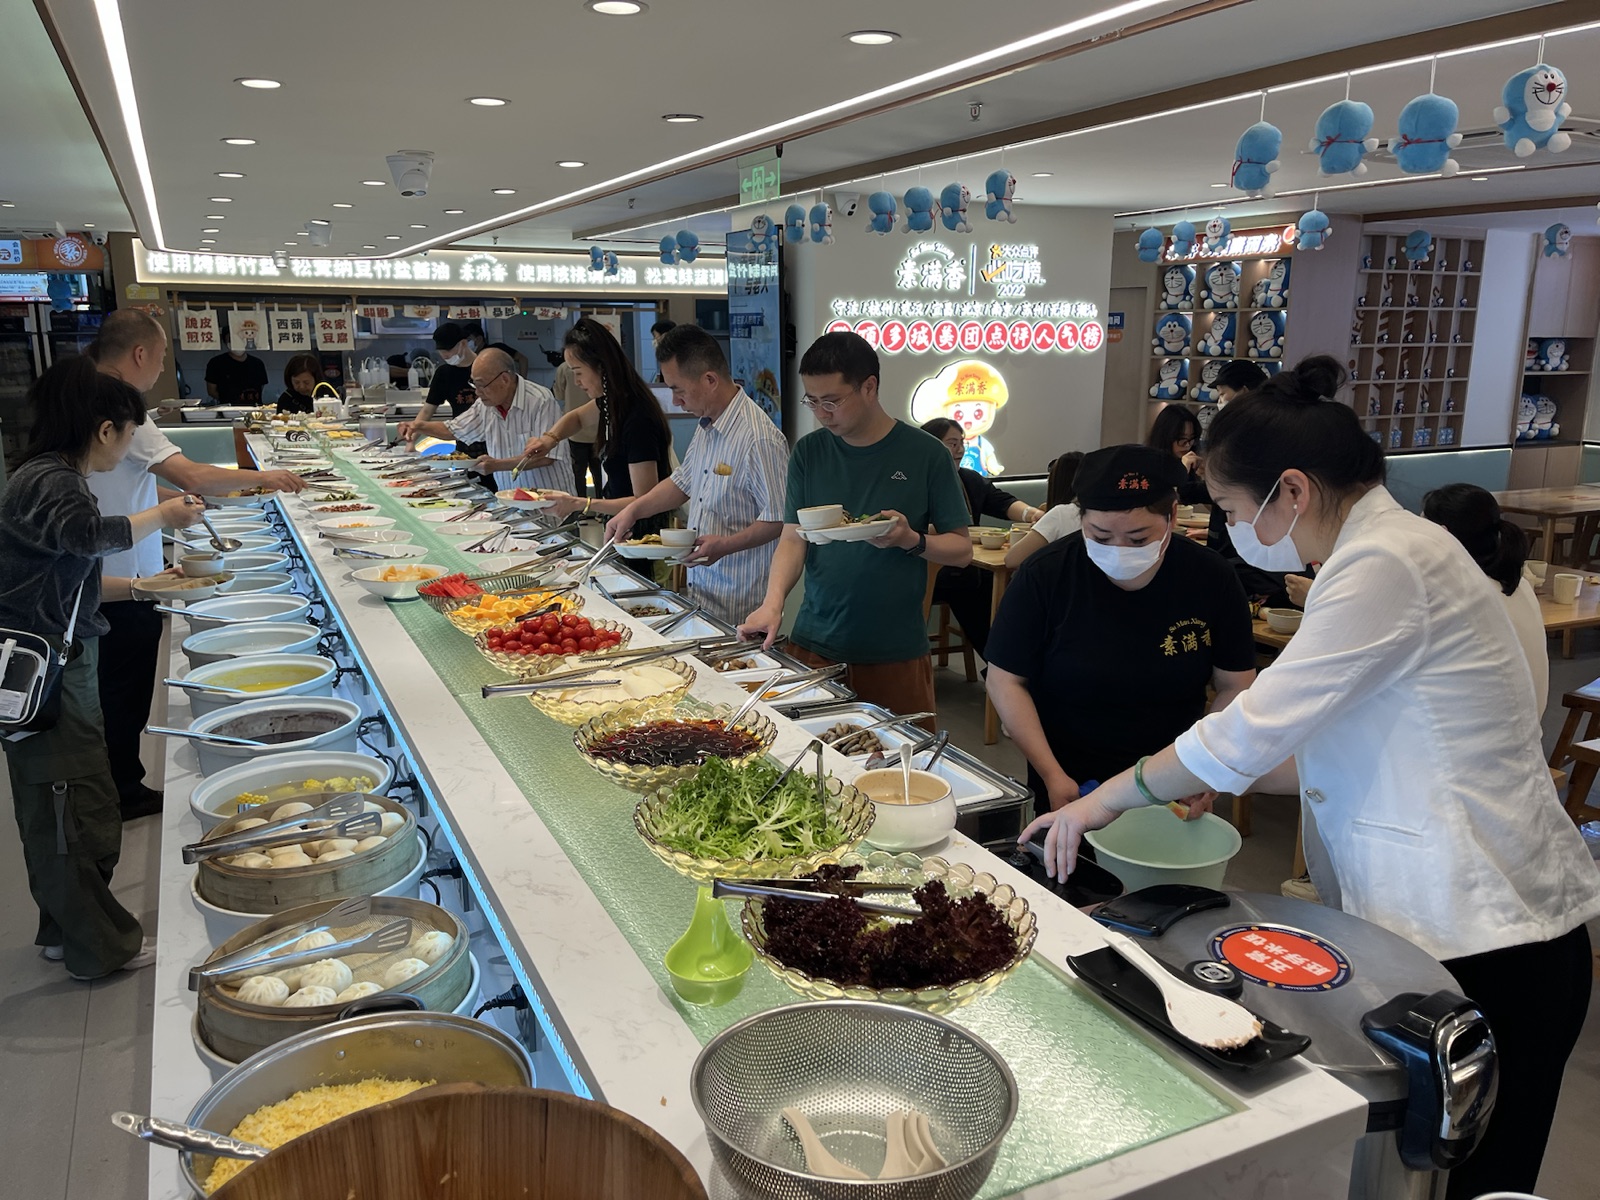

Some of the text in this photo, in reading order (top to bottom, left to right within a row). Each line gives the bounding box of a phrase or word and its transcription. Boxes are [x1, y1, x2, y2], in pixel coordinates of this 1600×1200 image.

[1002, 245, 1038, 258] 大众点评
[897, 259, 966, 289] 素满香
[998, 284, 1025, 296] 2022
[185, 316, 212, 329] 脆皮
[276, 318, 303, 330] 西葫
[320, 318, 347, 330] 农家
[186, 331, 214, 343] 煎饺
[278, 332, 305, 344] 芦饼
[322, 332, 349, 344] 豆腐
[833, 325, 1100, 347] 顶多城美团点评人气榜
[955, 381, 987, 396] 素满香
[1118, 478, 1150, 490] 素满香
[1160, 628, 1212, 656] 素满香
[1244, 950, 1293, 974] 五常
